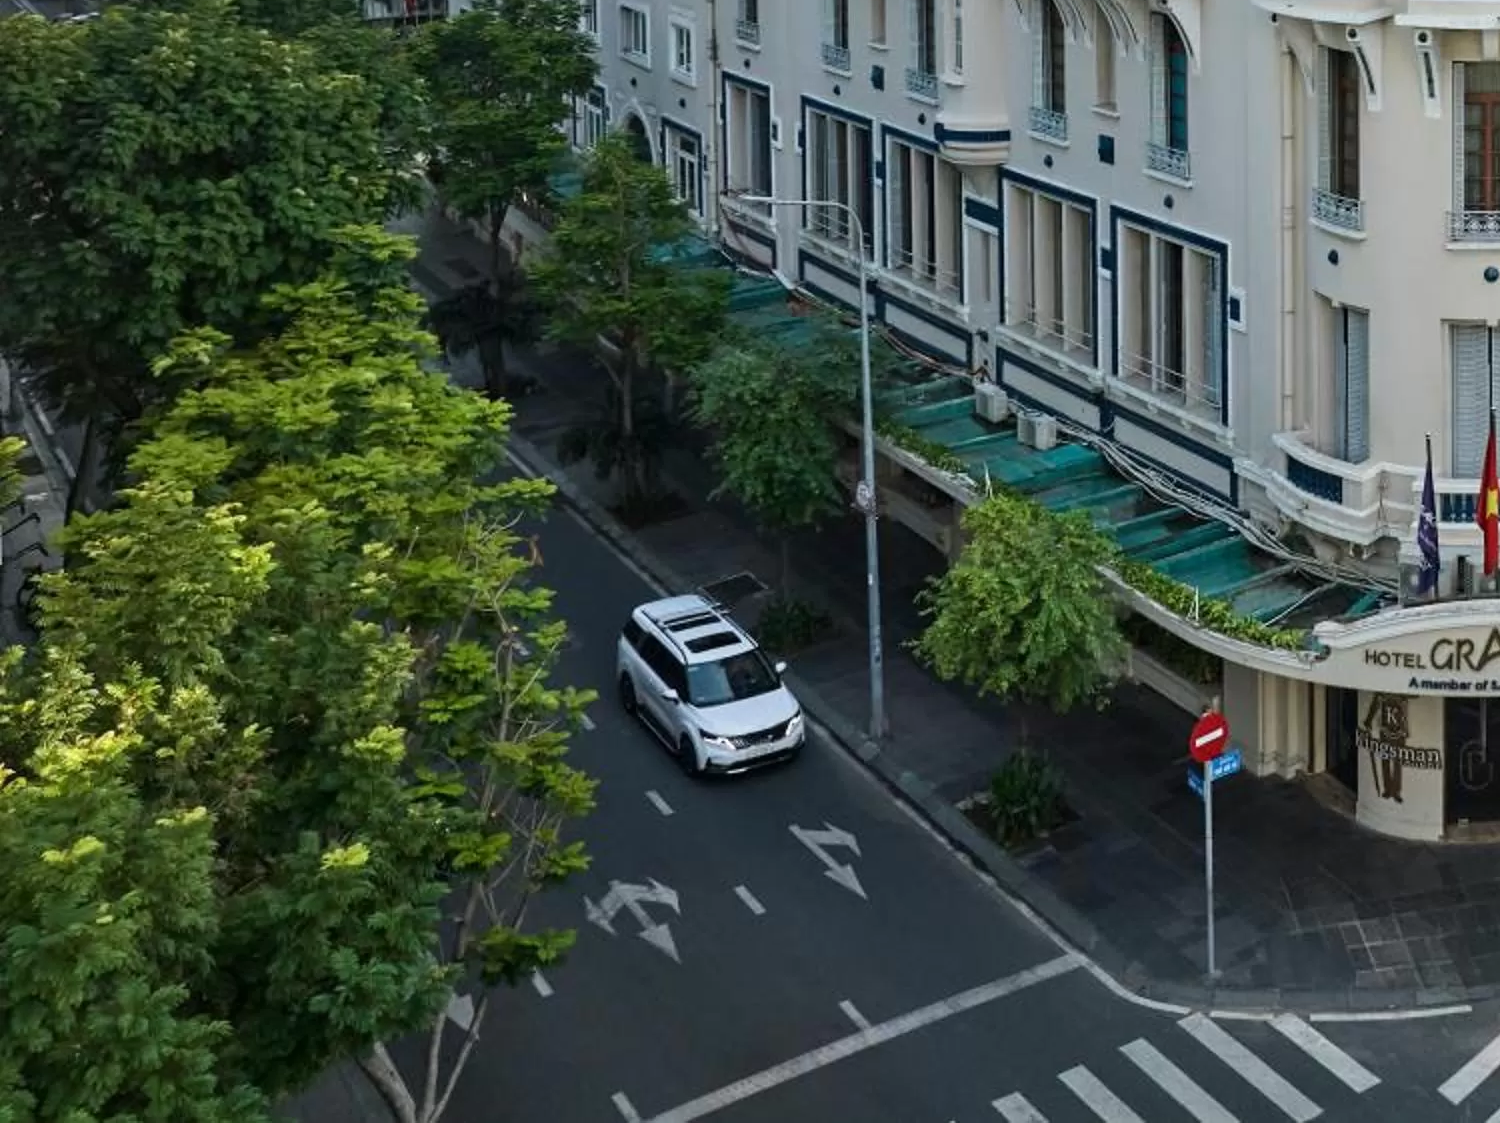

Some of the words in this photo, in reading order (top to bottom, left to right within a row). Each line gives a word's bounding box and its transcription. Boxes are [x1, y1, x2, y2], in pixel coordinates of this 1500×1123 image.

[1364, 649, 1426, 670] HOTEL
[1408, 677, 1419, 689] A
[1421, 679, 1471, 691] member
[1476, 679, 1488, 691] of
